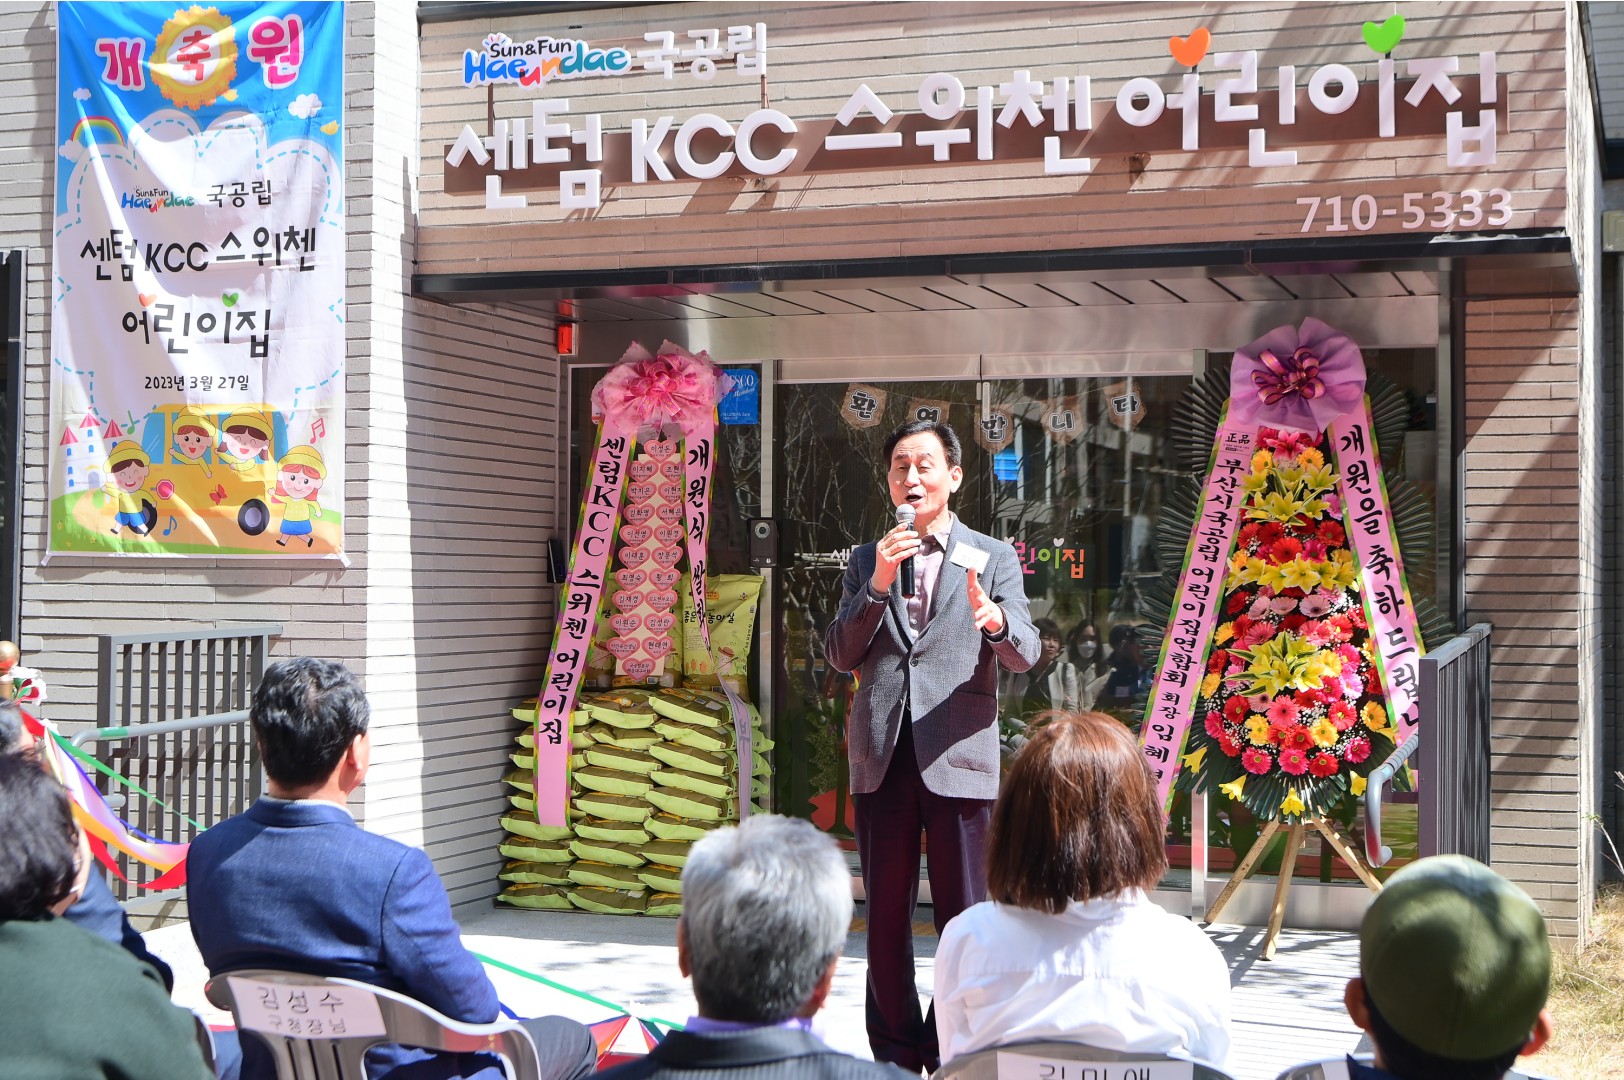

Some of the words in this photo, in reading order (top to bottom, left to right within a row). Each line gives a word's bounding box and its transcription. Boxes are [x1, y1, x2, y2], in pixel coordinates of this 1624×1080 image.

[98, 38, 143, 88] 개
[176, 30, 211, 81] 축
[250, 18, 301, 86] 원
[465, 41, 628, 87] Haeundae
[637, 22, 766, 80] 국공립
[490, 39, 571, 58] Sun&Fun
[445, 99, 602, 209] 센텀
[632, 108, 798, 183] KCC
[825, 68, 1091, 174] 스위첸
[1115, 50, 1497, 168] 어린이집
[121, 191, 195, 213] Haeundae
[206, 179, 272, 208] 국공립
[135, 188, 169, 197] Sun&Fun
[1296, 188, 1513, 233] 710-5333
[80, 229, 138, 282] 센텀
[145, 241, 209, 273] KCC
[216, 225, 316, 272] 스위첸
[122, 303, 271, 358] 어린이집
[144, 375, 185, 391] 2023년
[189, 374, 216, 392] 3월
[218, 374, 250, 391] 27일
[688, 438, 710, 546] 개원식
[1340, 424, 1383, 536] 개원을
[1014, 541, 1085, 579] 린이집
[561, 569, 601, 640] 스위첸
[538, 648, 579, 745] 어린이집
[257, 986, 345, 1014] 김성수
